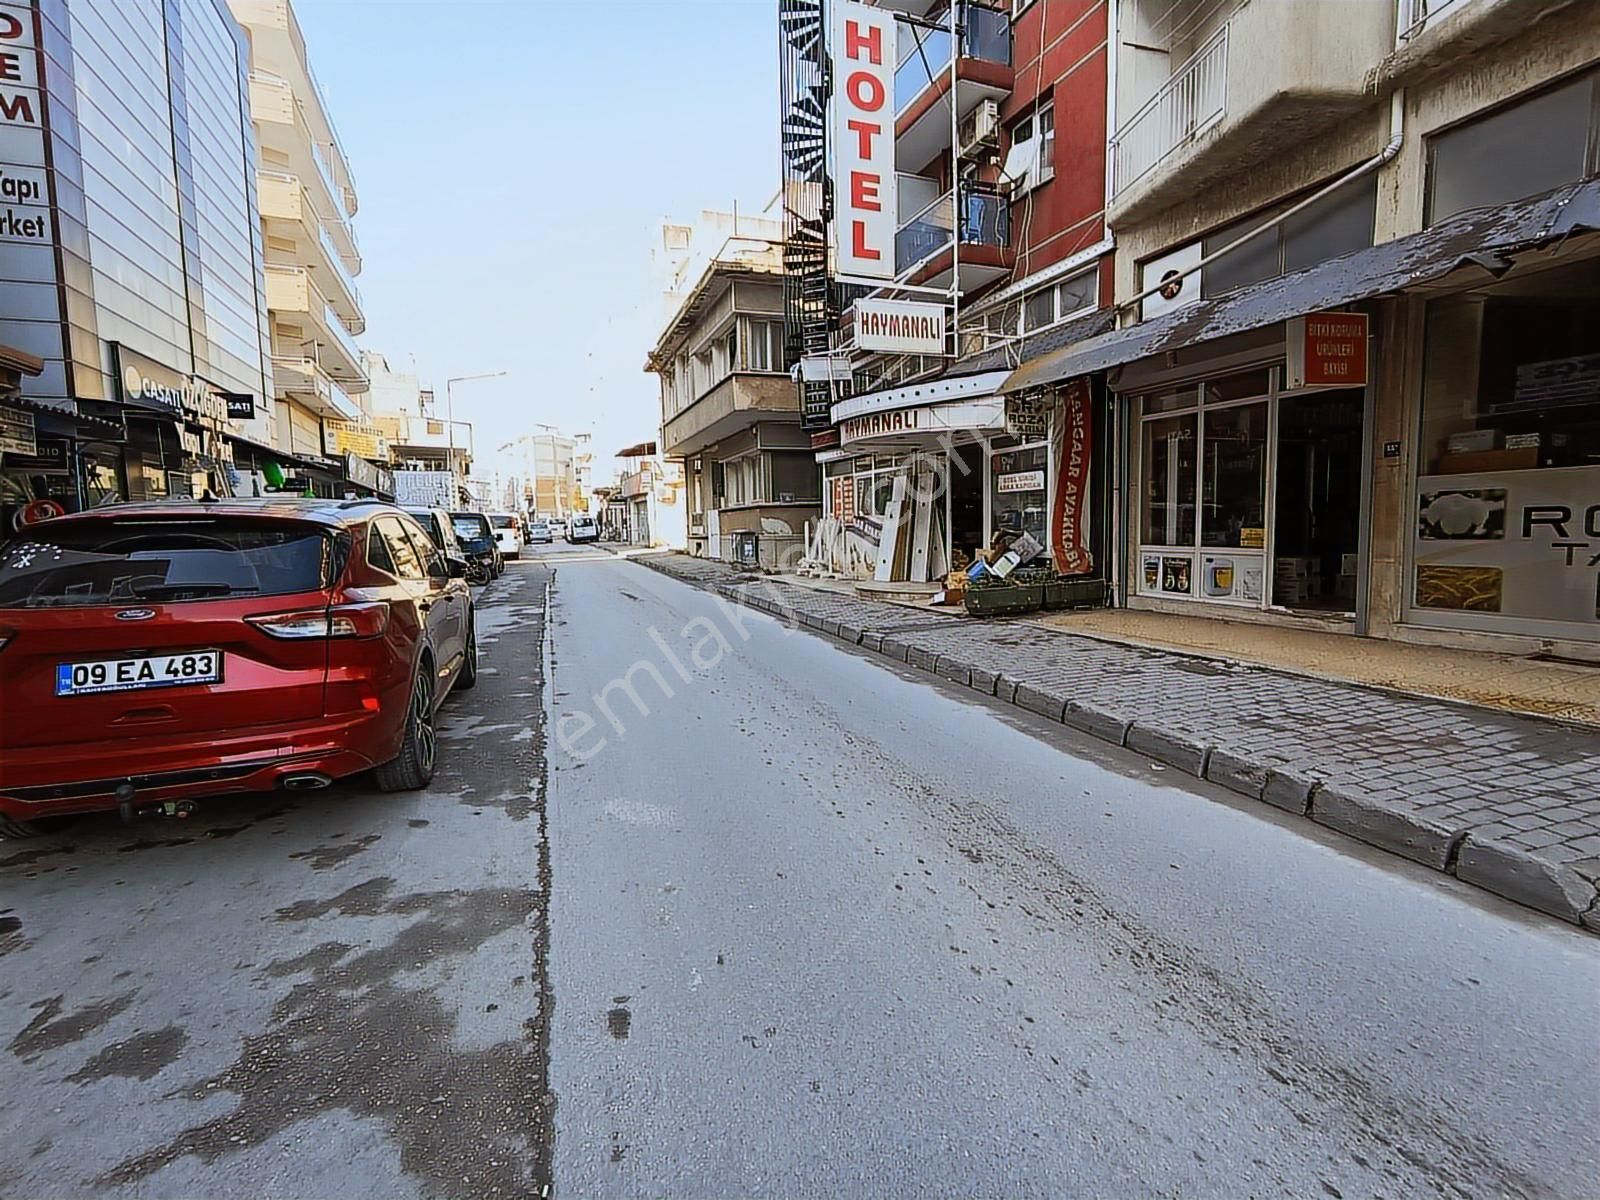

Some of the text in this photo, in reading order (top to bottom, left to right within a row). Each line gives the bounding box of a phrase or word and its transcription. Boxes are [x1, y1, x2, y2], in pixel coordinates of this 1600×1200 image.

[845, 19, 885, 261] HOTEL
[0, 170, 39, 205] apı
[861, 311, 940, 340] HAYMANALI
[73, 655, 214, 687] 09 EA 483
